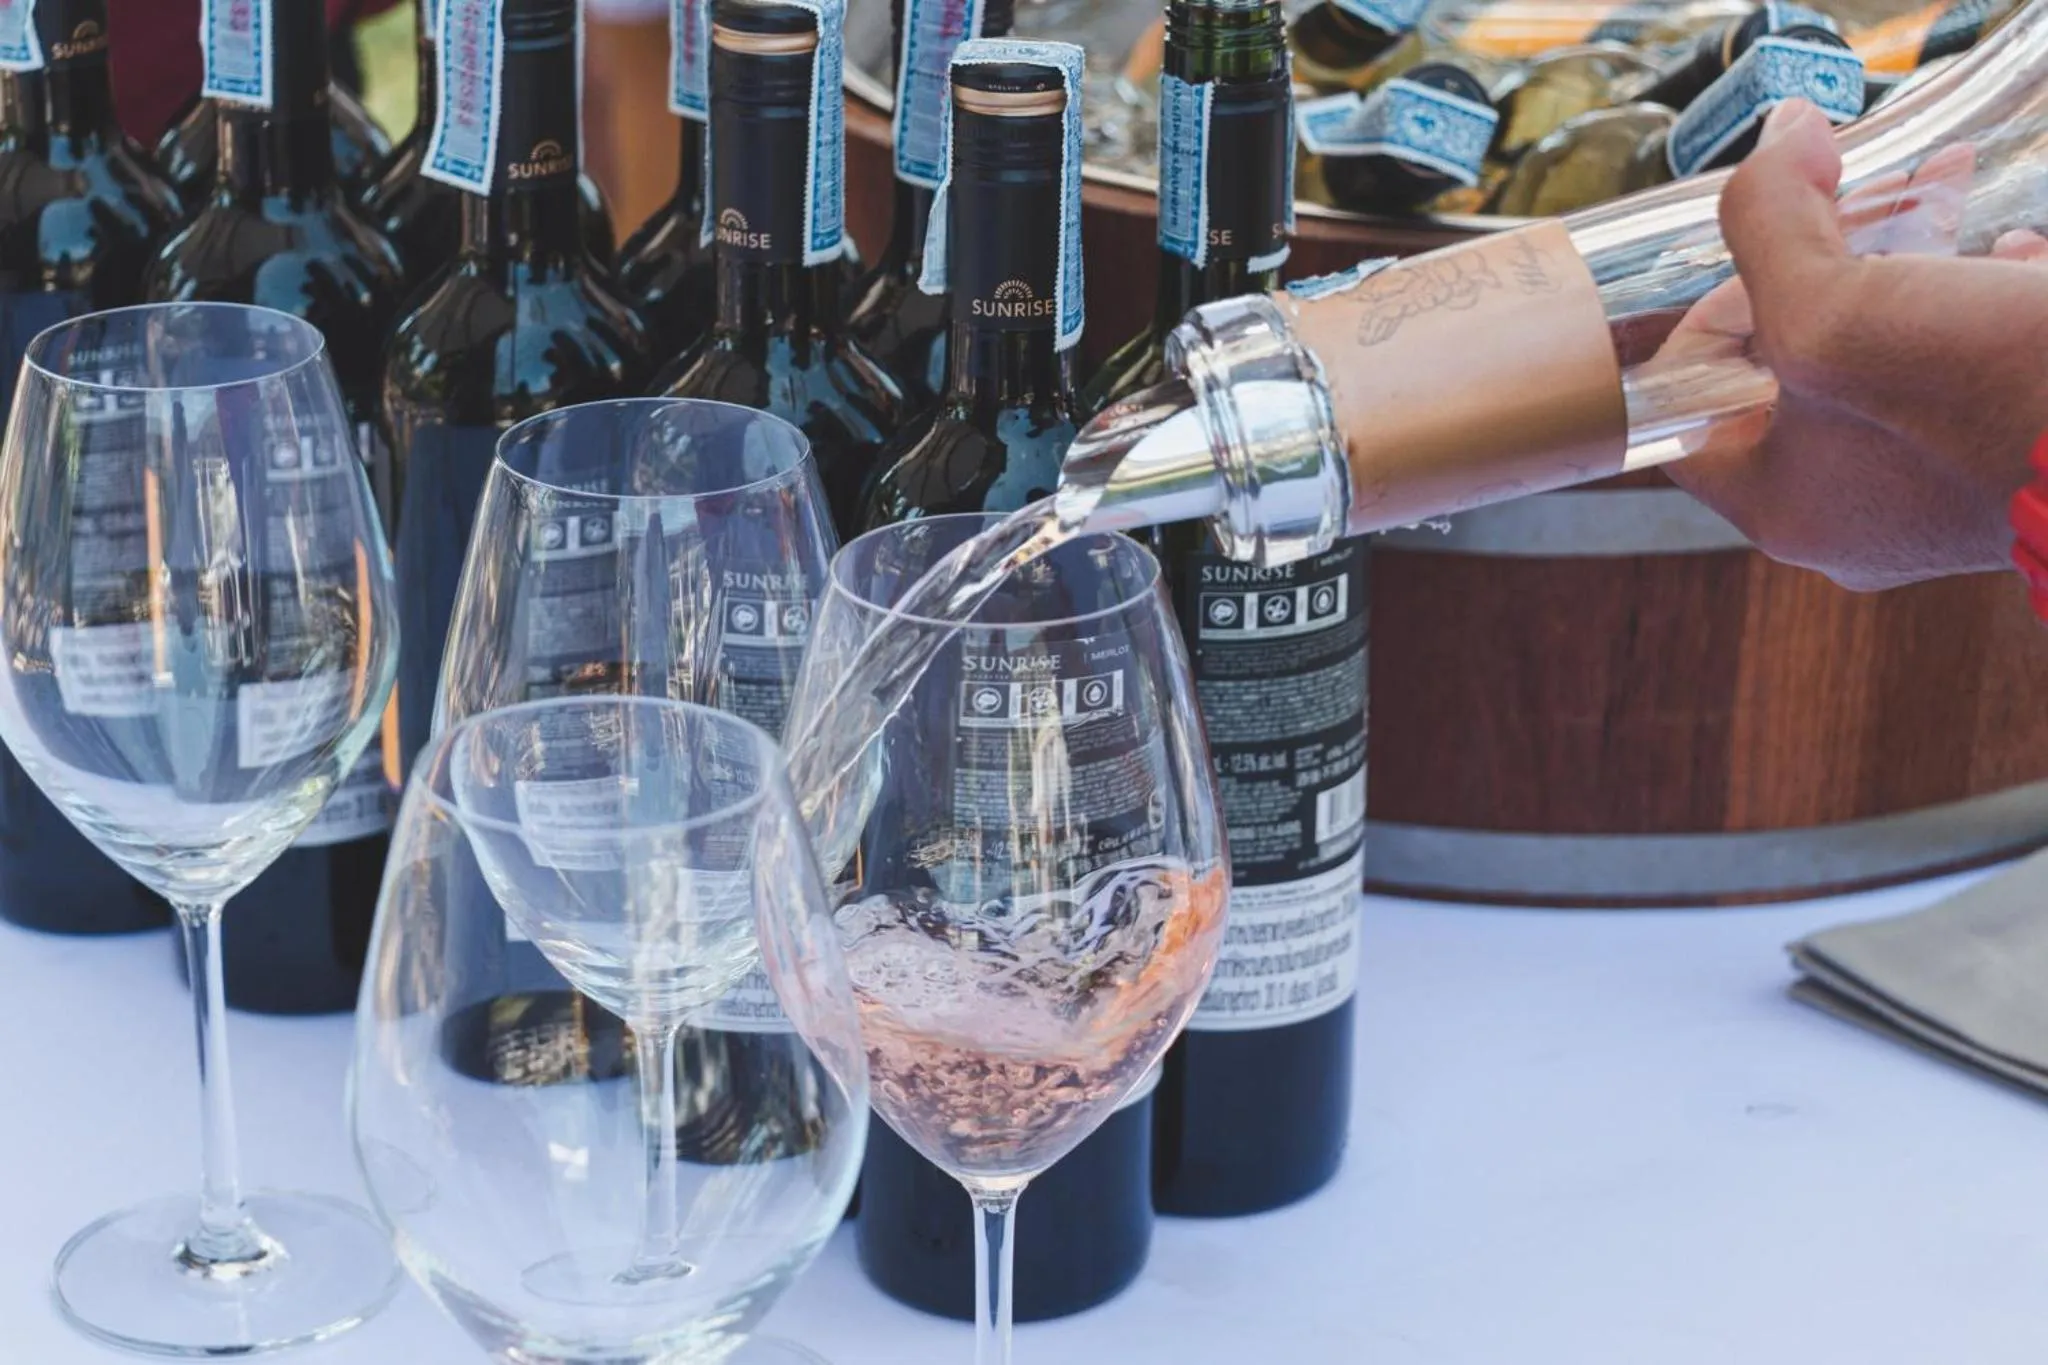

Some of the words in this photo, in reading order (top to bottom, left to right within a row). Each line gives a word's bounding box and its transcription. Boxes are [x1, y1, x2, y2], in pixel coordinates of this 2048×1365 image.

[972, 298, 1055, 318] SUNRISE
[1201, 562, 1297, 583] SUNRISE
[961, 653, 1063, 673] SUNRISE
[1090, 644, 1131, 662] MERLOT
